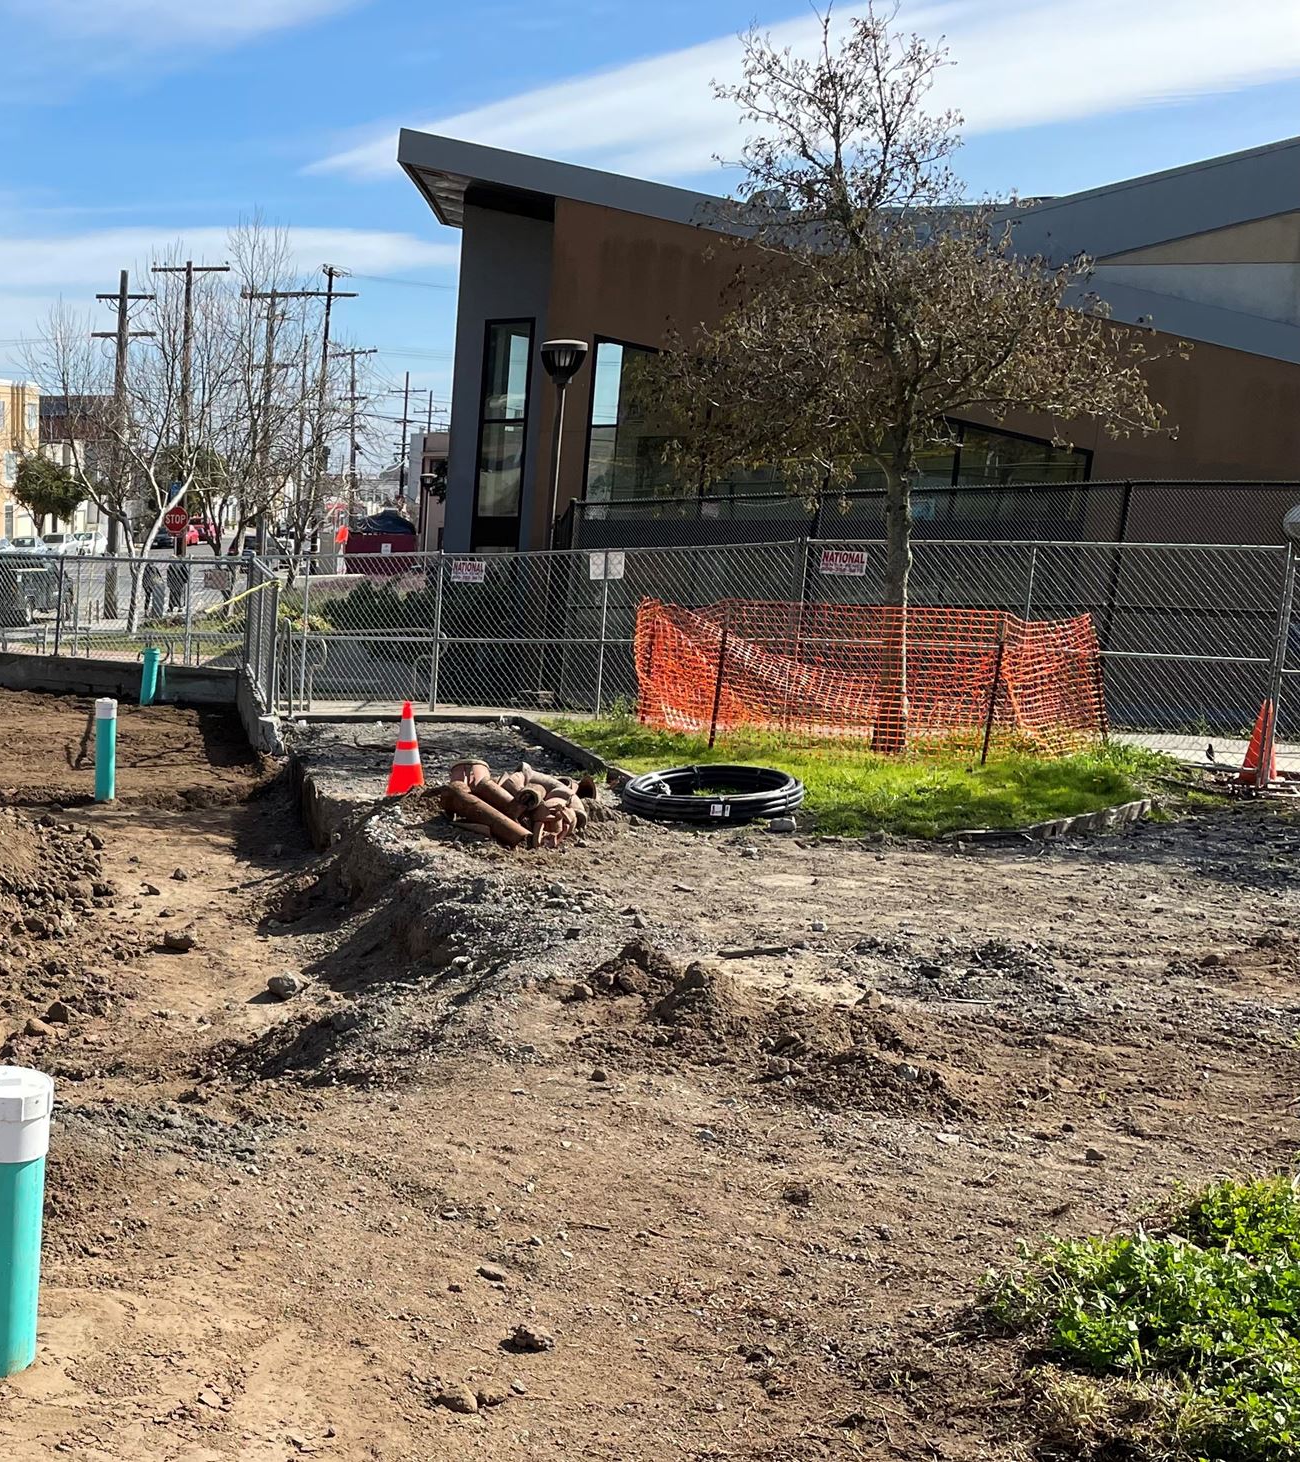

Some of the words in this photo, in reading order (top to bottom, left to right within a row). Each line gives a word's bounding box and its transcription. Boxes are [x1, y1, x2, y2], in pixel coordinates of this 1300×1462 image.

[165, 514, 186, 524] STOP
[822, 552, 865, 564] NATIONAL
[452, 561, 484, 573] NATIONAL
